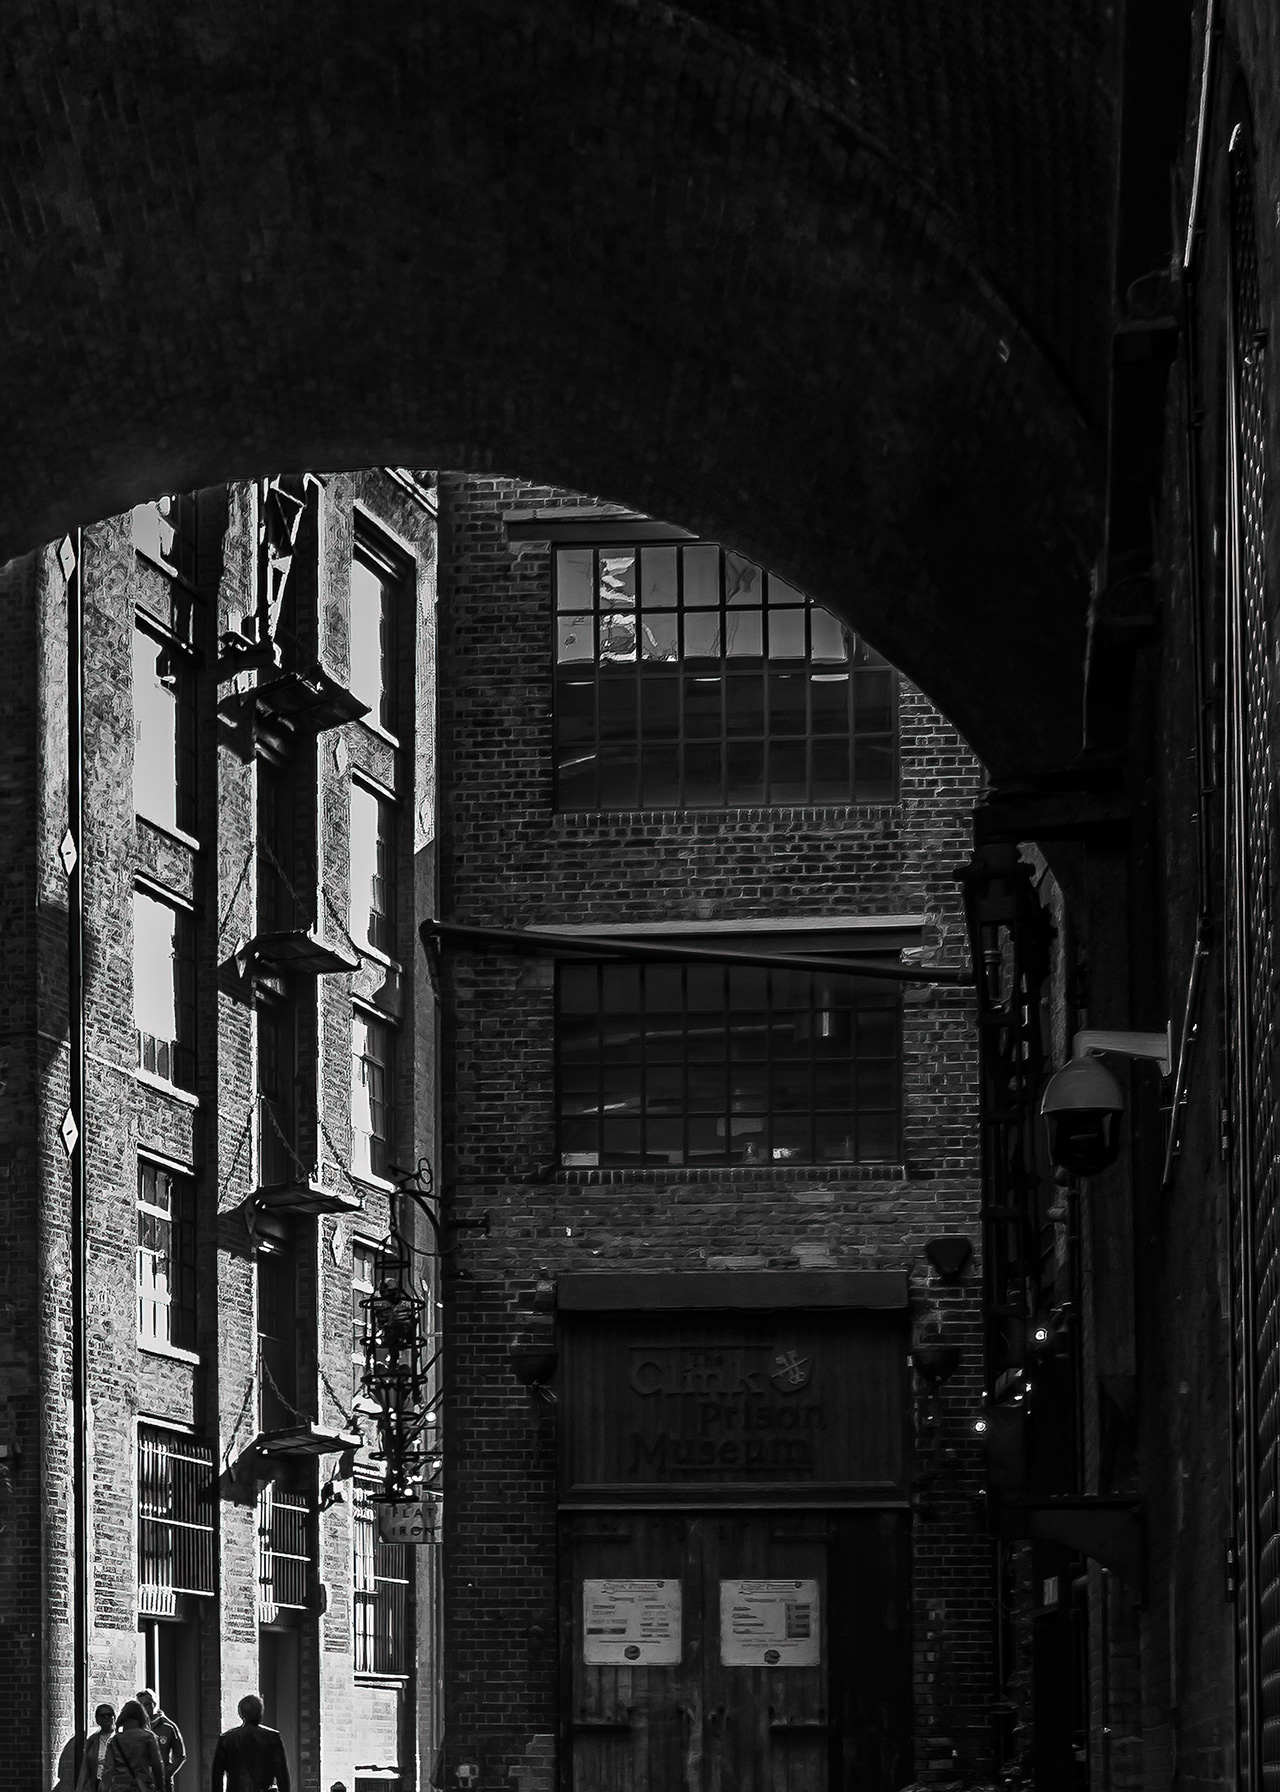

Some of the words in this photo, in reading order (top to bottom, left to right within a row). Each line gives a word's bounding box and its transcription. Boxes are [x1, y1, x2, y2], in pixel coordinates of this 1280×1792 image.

[629, 1359, 765, 1397] Clink
[698, 1402, 826, 1437] Prison
[629, 1432, 811, 1473] Museum
[392, 1508, 434, 1518] FLAT
[392, 1526, 435, 1537] IRON
